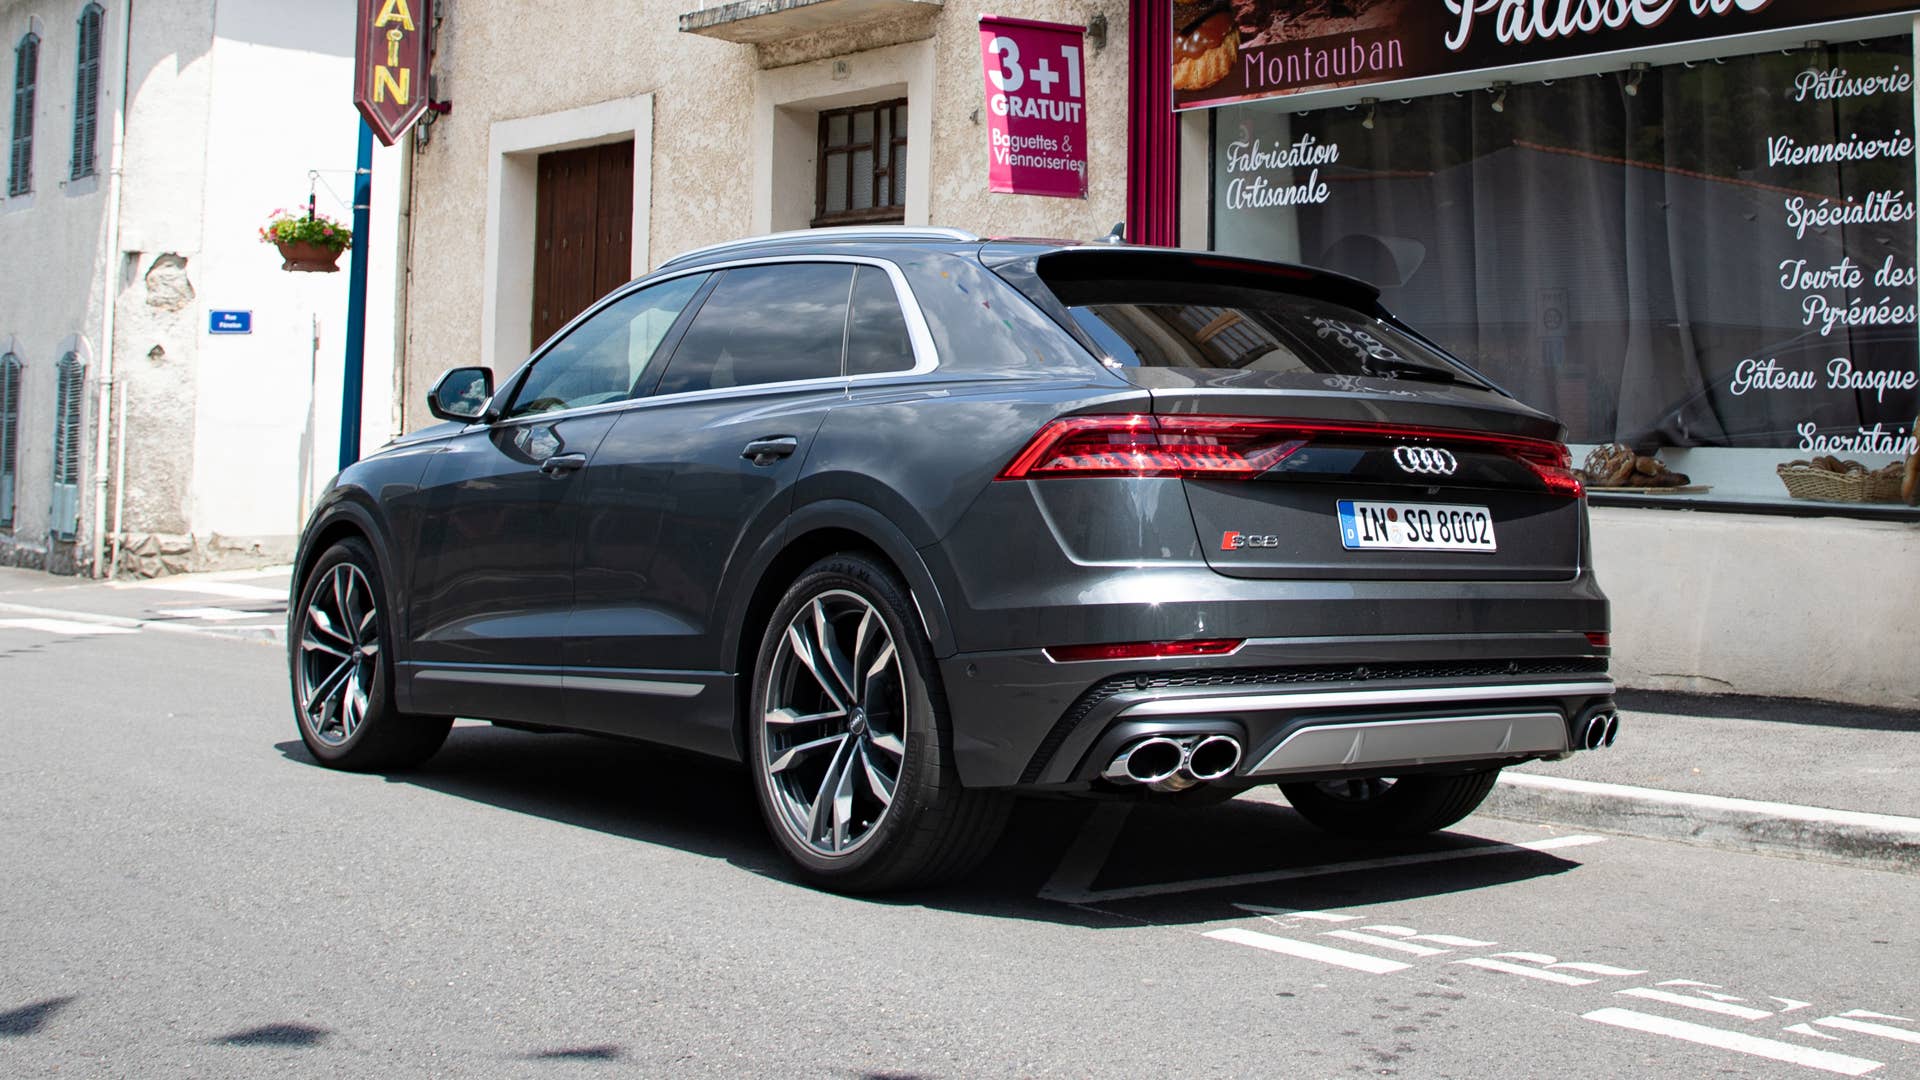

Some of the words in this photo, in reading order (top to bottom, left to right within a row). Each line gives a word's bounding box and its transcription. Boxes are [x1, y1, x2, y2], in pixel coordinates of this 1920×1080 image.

[988, 36, 1081, 98] 3+1
[1244, 37, 1403, 88] Montauban
[1795, 65, 1915, 102] Pâtisserie
[991, 94, 1081, 123] GRATUIT
[992, 128, 1058, 152] Baguettes
[1061, 135, 1073, 152] &
[994, 147, 1084, 172] Viennoiseries
[1227, 133, 1340, 173] Fabrication
[1768, 129, 1916, 168] Viennoiserie
[1226, 168, 1331, 210] Artisanale
[1785, 190, 1917, 240] Spécialités
[1779, 256, 1865, 290] Tourte
[1874, 254, 1917, 287] des
[1802, 294, 1918, 336] Pyrénées
[1730, 358, 1817, 396] Gâteau
[1826, 358, 1919, 403] Basque
[1797, 422, 1919, 455] Sacristain
[1359, 507, 1389, 542] IN
[1404, 508, 1434, 543] SQ
[1437, 510, 1490, 544] 8002
